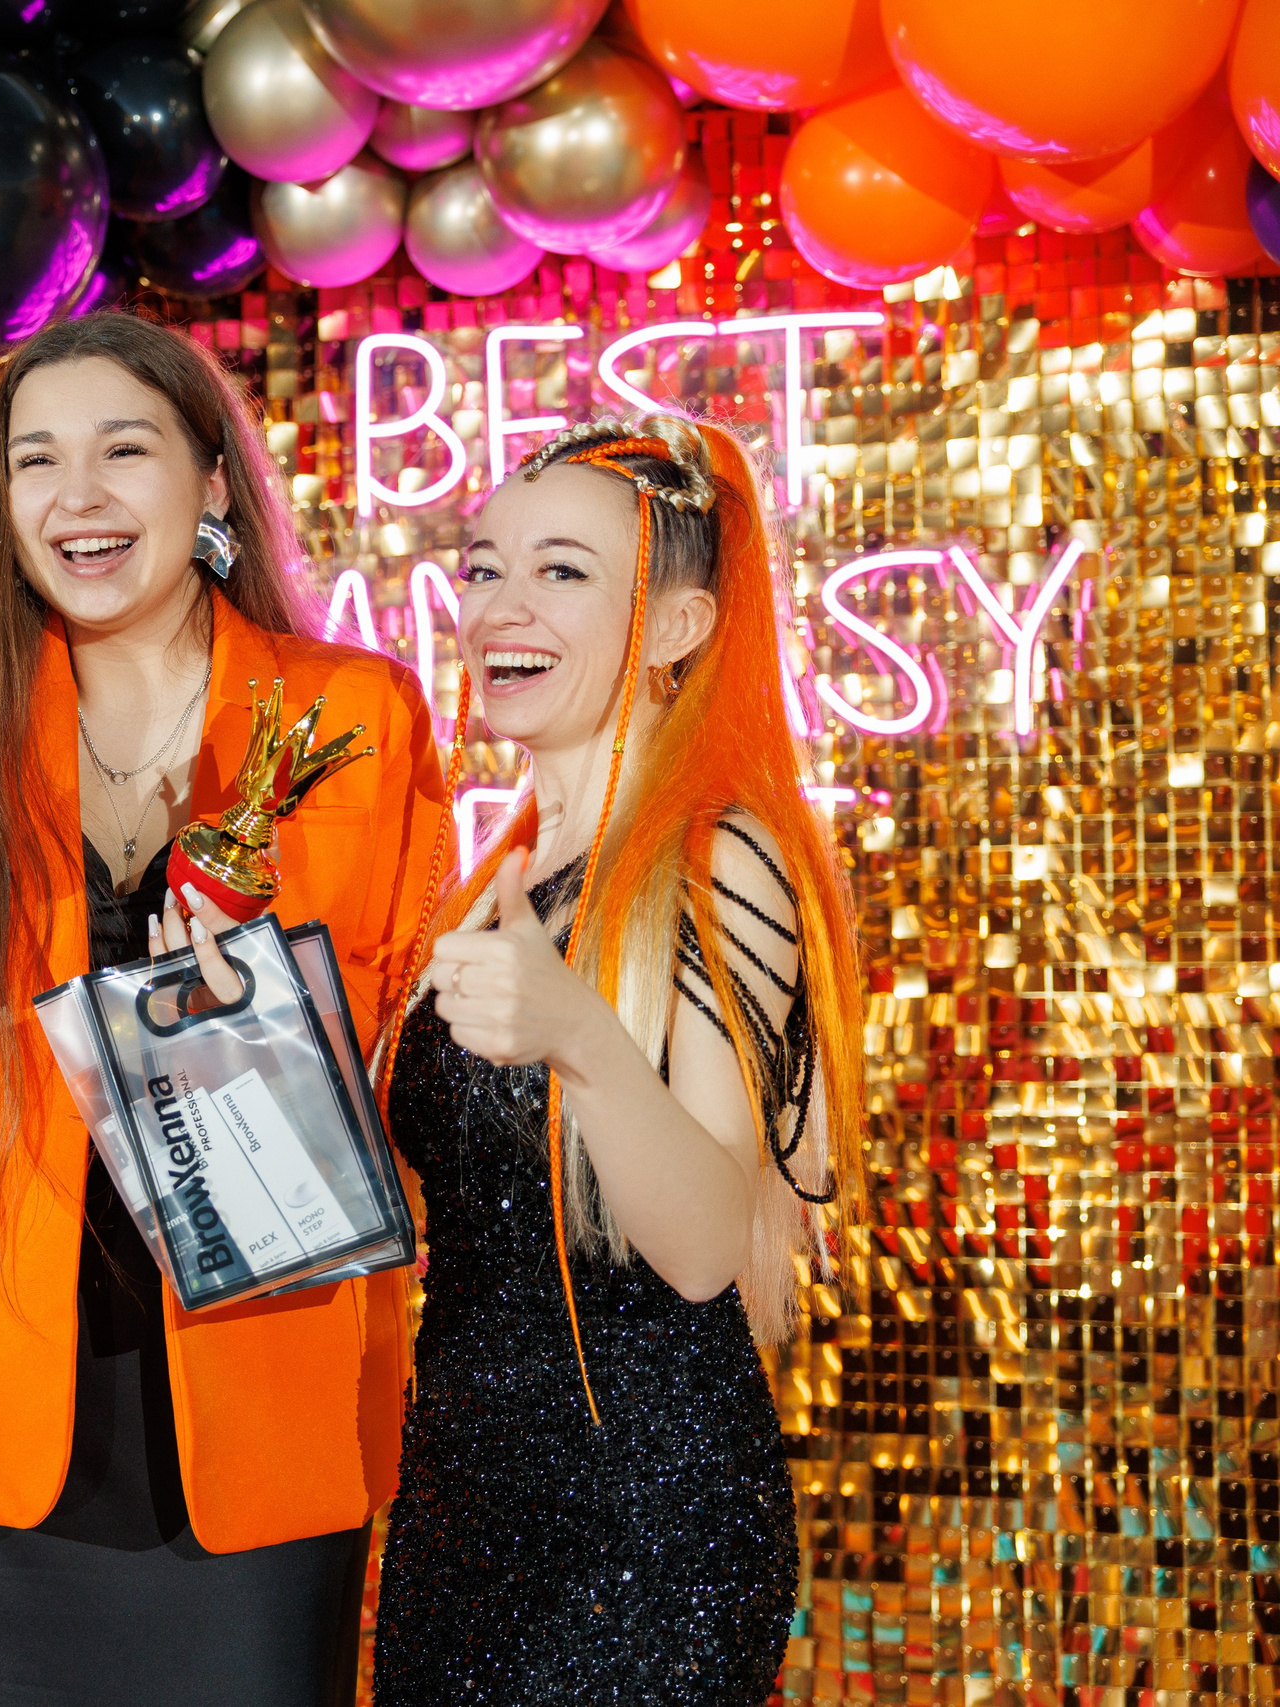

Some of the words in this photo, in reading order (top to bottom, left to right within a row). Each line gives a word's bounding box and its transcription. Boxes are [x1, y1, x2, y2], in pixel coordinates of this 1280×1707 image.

[177, 1067, 213, 1152] PROFESSIONAL
[147, 1073, 235, 1276] BrowXenna
[297, 1207, 325, 1228] MONO
[302, 1219, 324, 1236] STEP
[248, 1231, 279, 1255] PLEX
